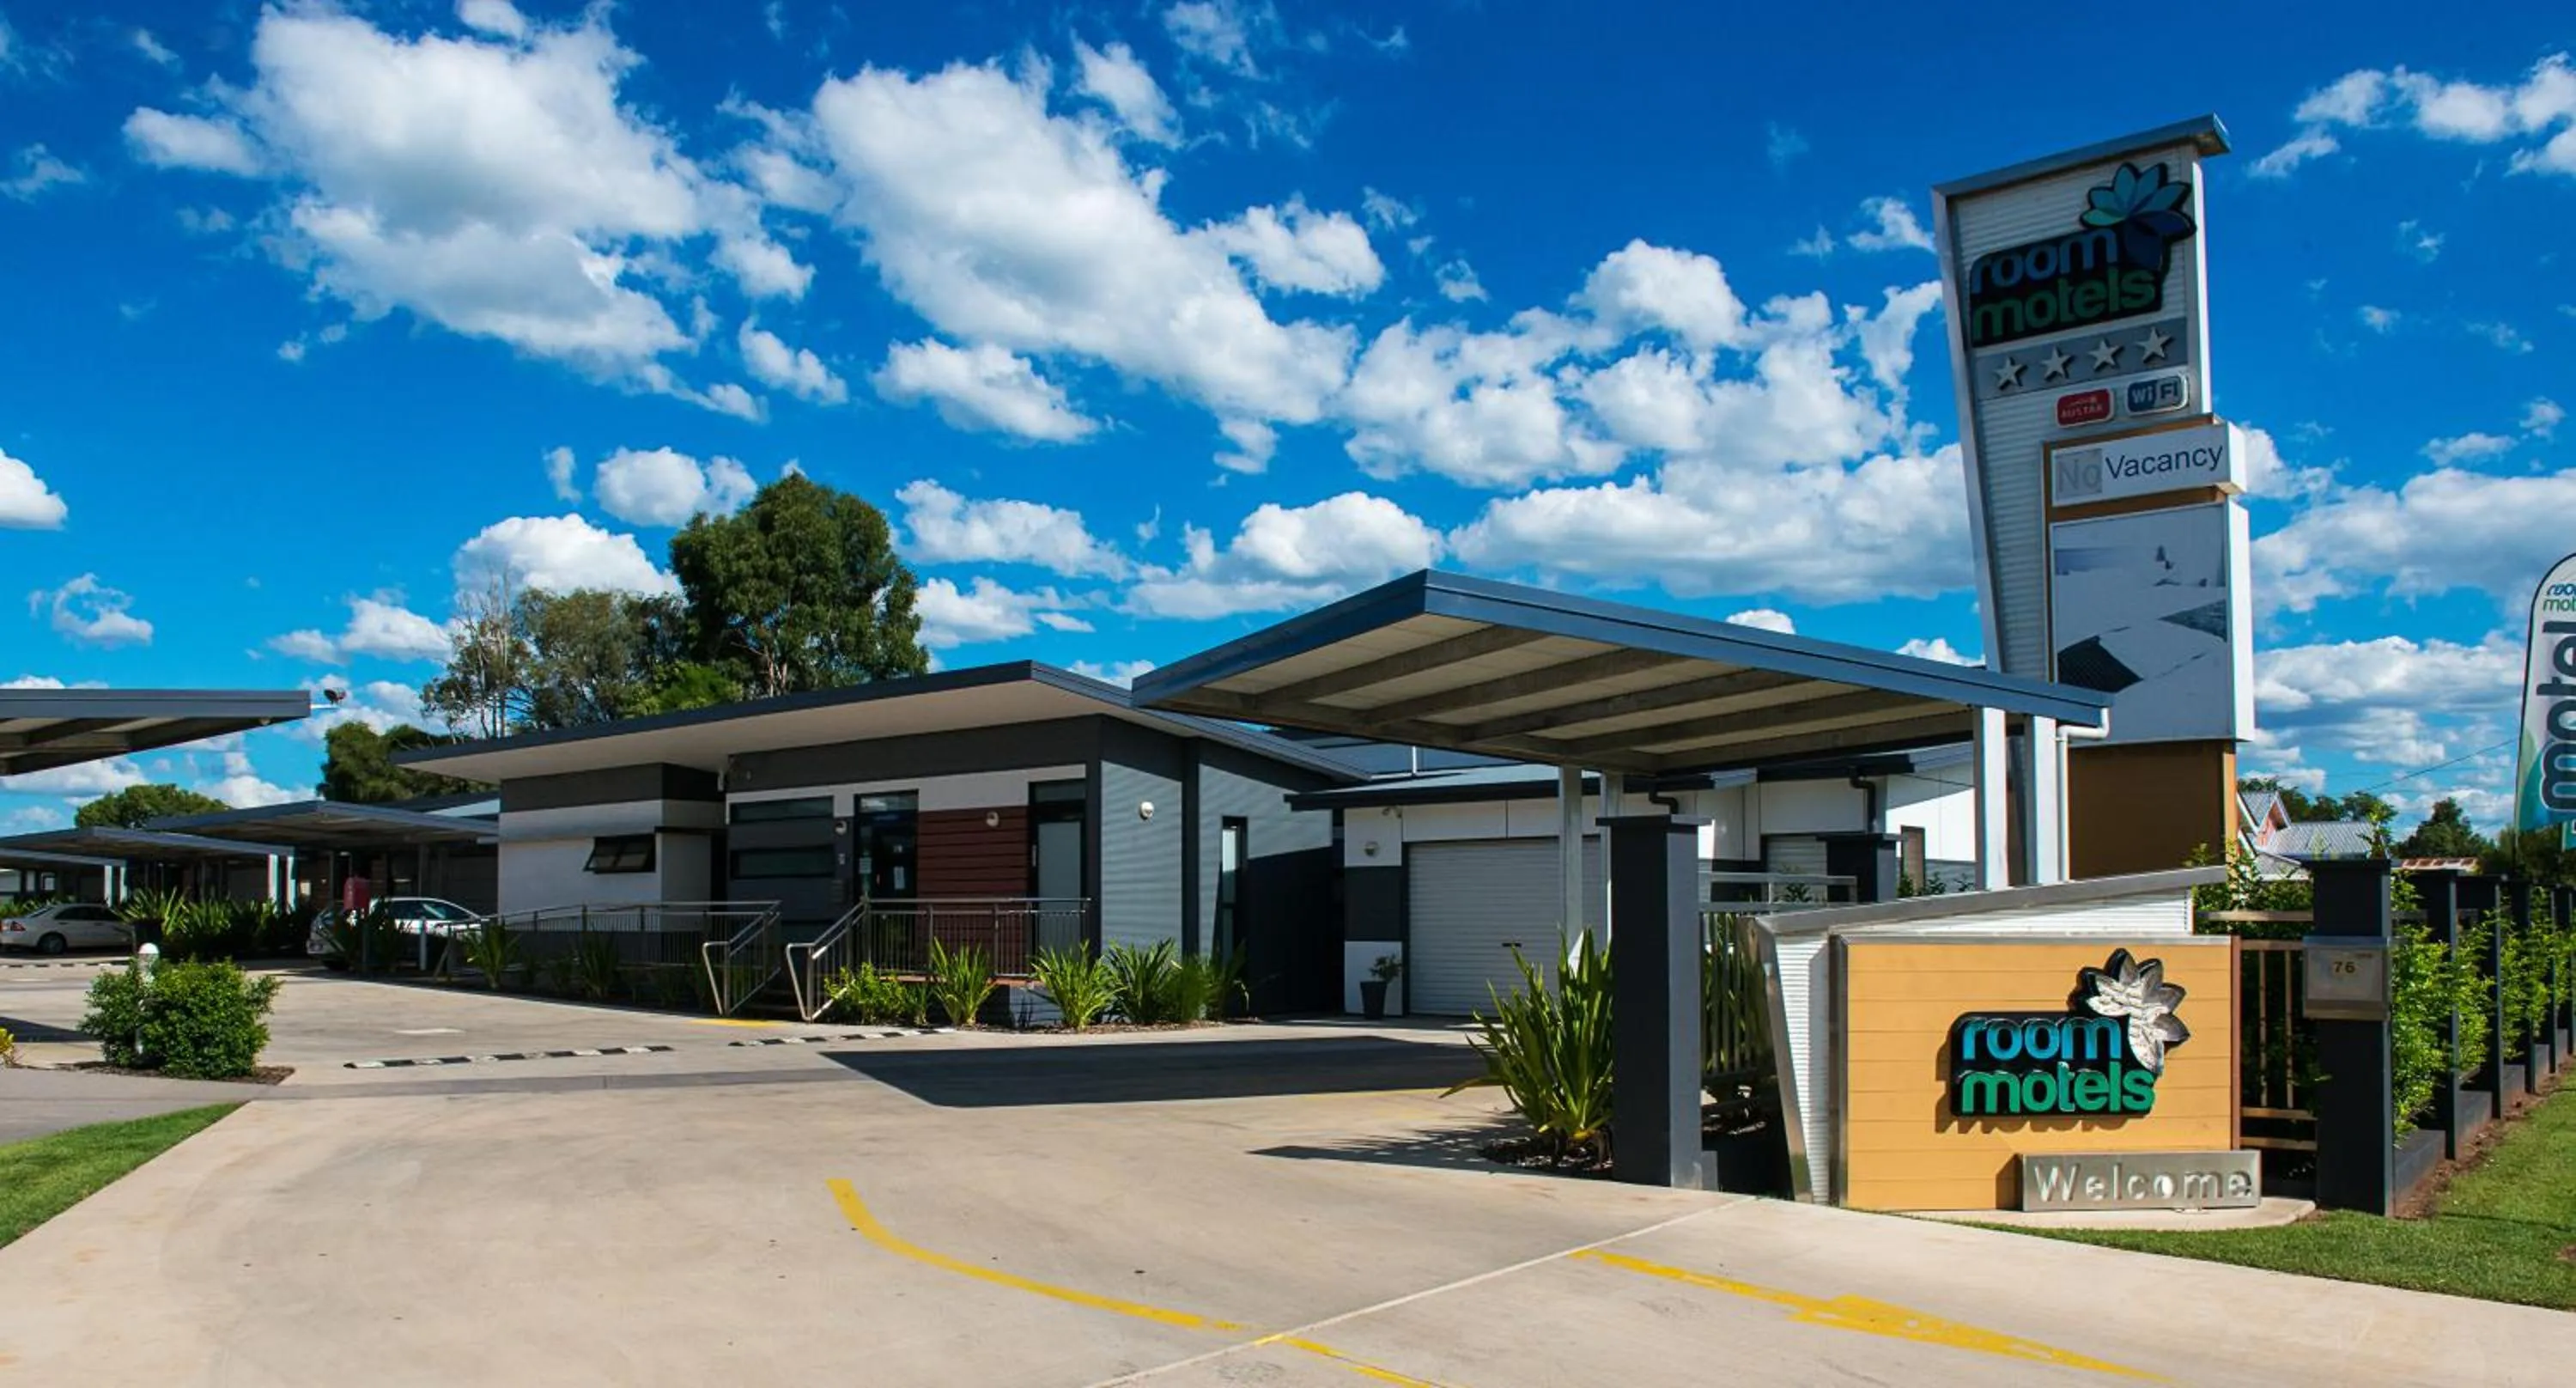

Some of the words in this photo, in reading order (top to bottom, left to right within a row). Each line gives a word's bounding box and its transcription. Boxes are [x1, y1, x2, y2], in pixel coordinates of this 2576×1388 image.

[1971, 228, 2118, 294] room
[1971, 267, 2157, 342] motels
[2105, 445, 2223, 479] Vacancy
[2334, 961, 2355, 973] 76
[1960, 1016, 2122, 1061] room
[1957, 1061, 2157, 1114] motels
[2032, 1161, 2255, 1203] Welcome
